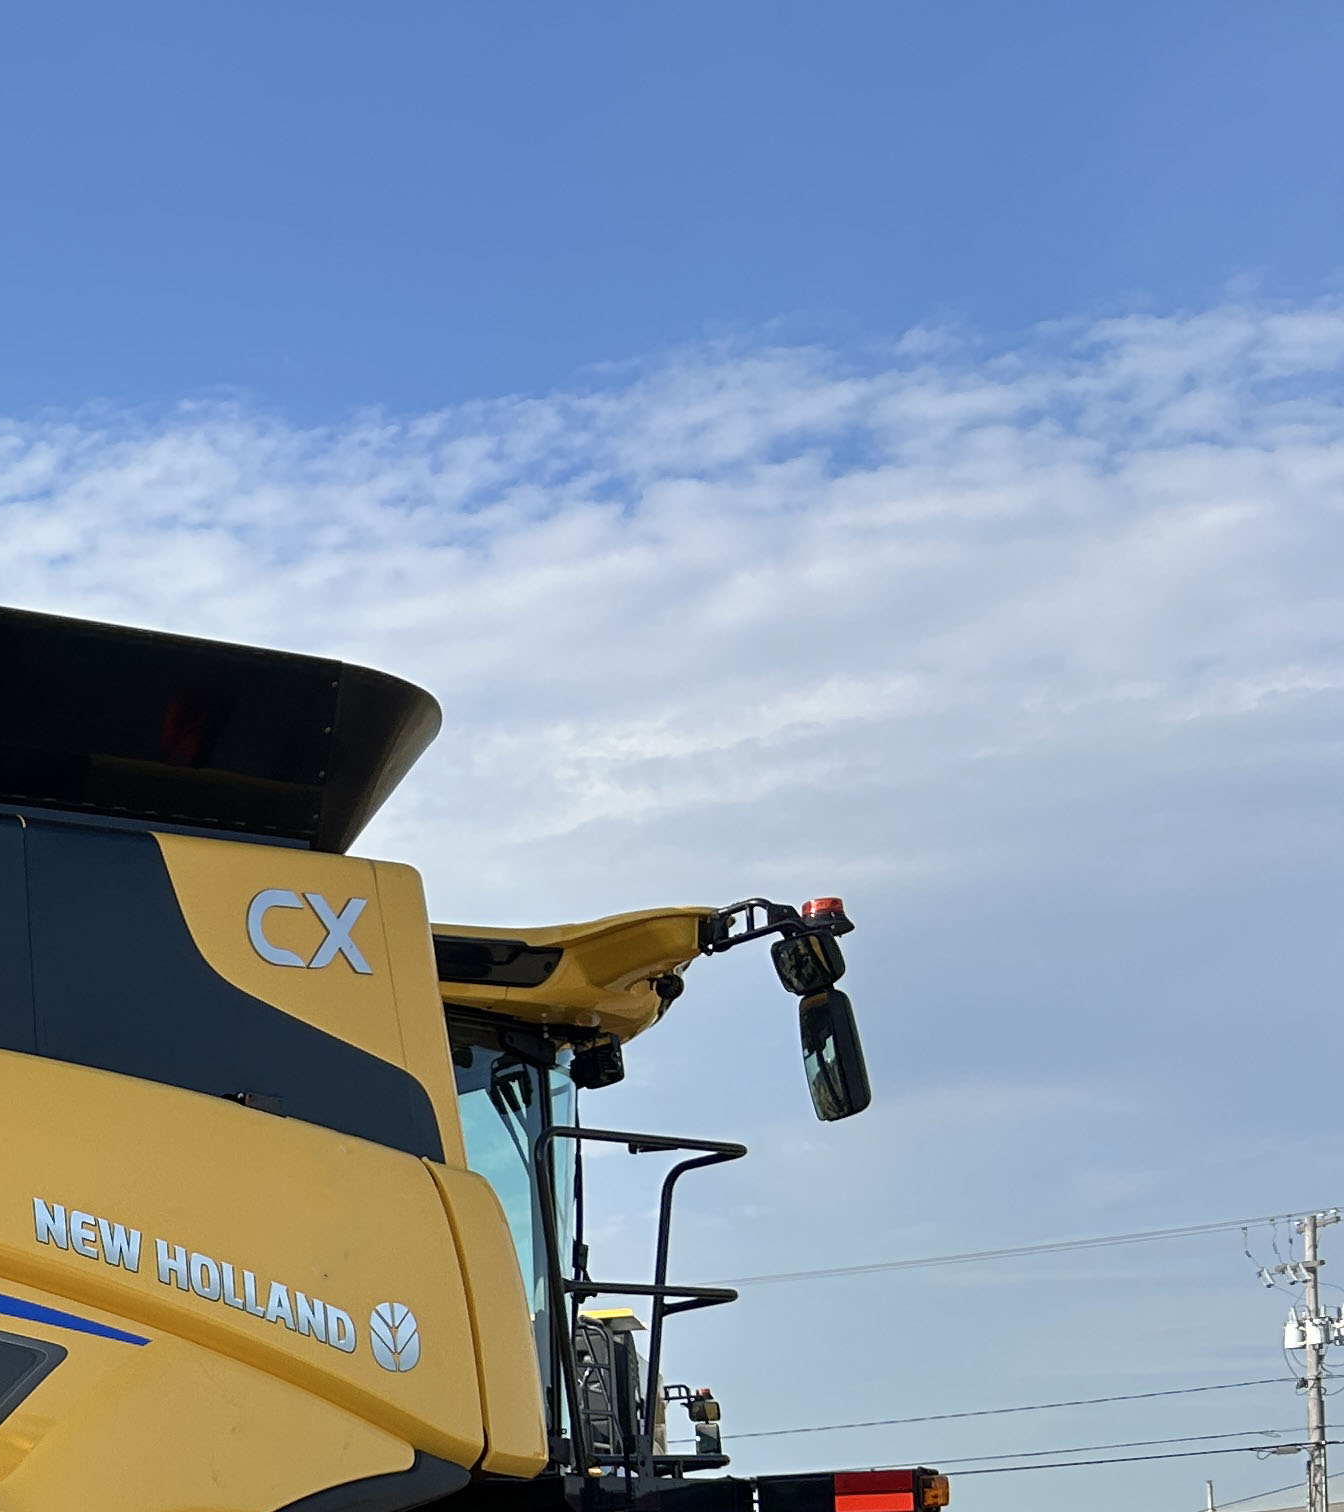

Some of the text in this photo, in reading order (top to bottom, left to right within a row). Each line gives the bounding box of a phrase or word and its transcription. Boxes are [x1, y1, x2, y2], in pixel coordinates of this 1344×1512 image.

[245, 887, 374, 976] CX
[32, 1196, 357, 1354] NEW HOLLAND
